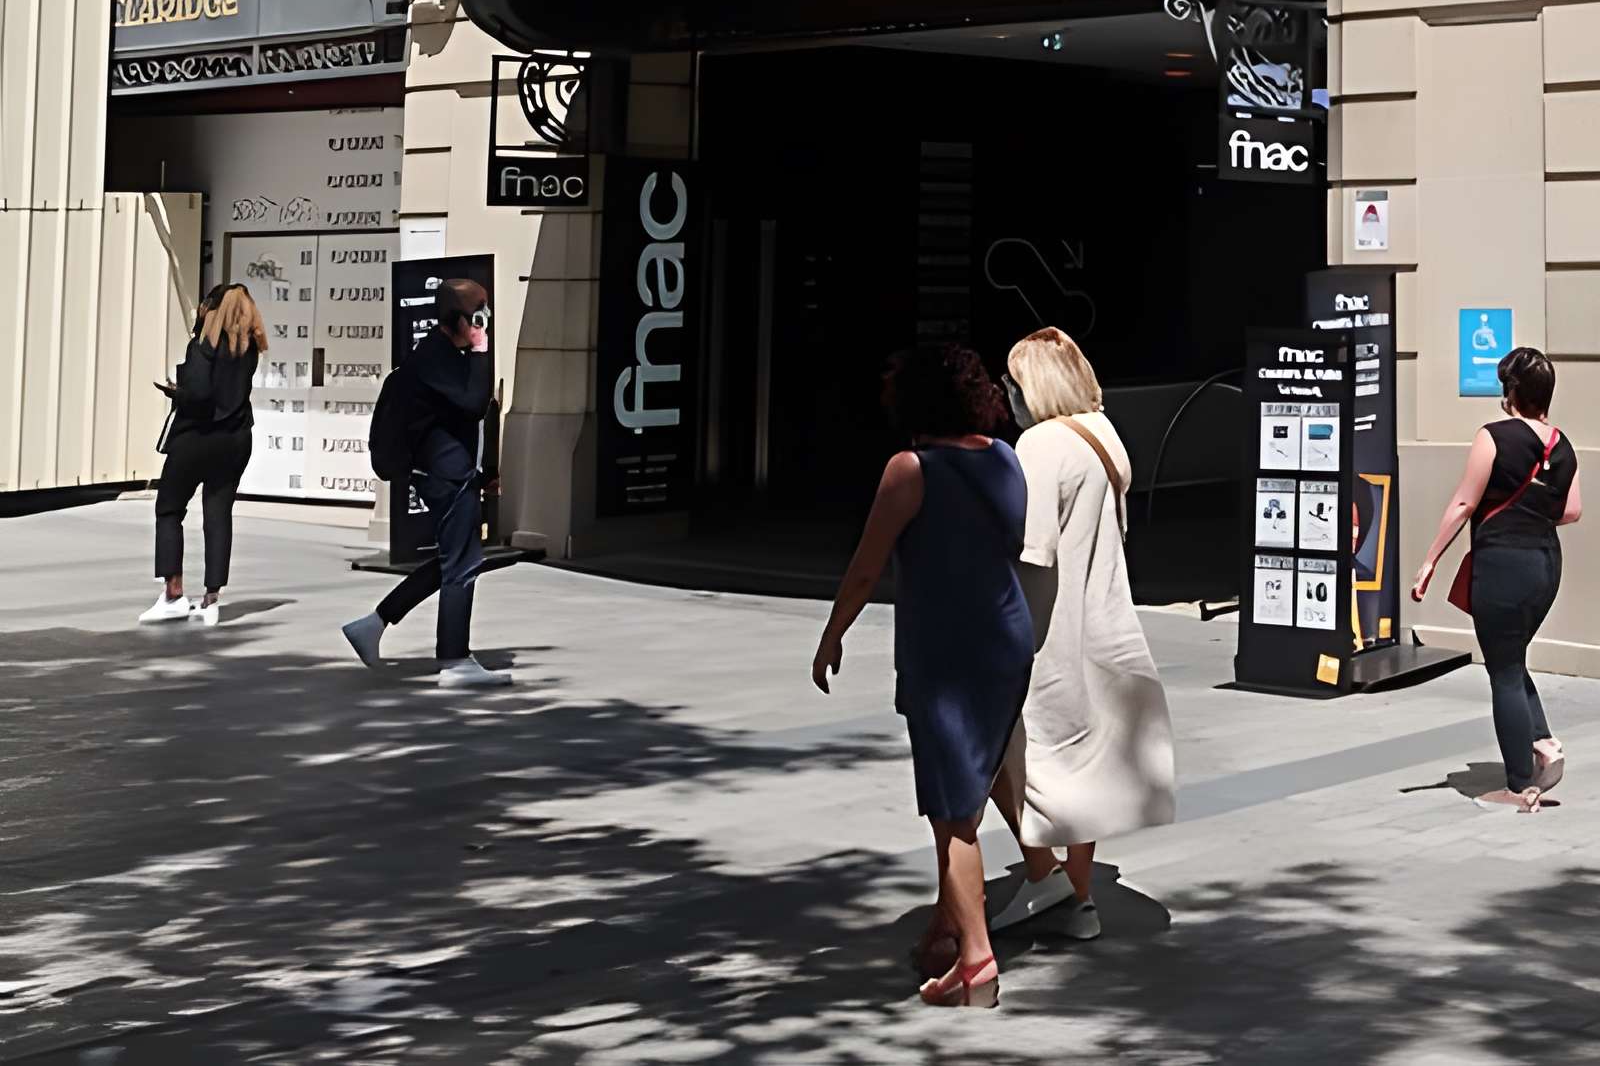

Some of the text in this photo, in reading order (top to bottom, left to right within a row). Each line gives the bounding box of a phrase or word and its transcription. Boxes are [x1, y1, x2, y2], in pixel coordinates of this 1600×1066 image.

[1229, 129, 1309, 172] fnac
[500, 166, 584, 199] fnac
[613, 171, 687, 434] fnac
